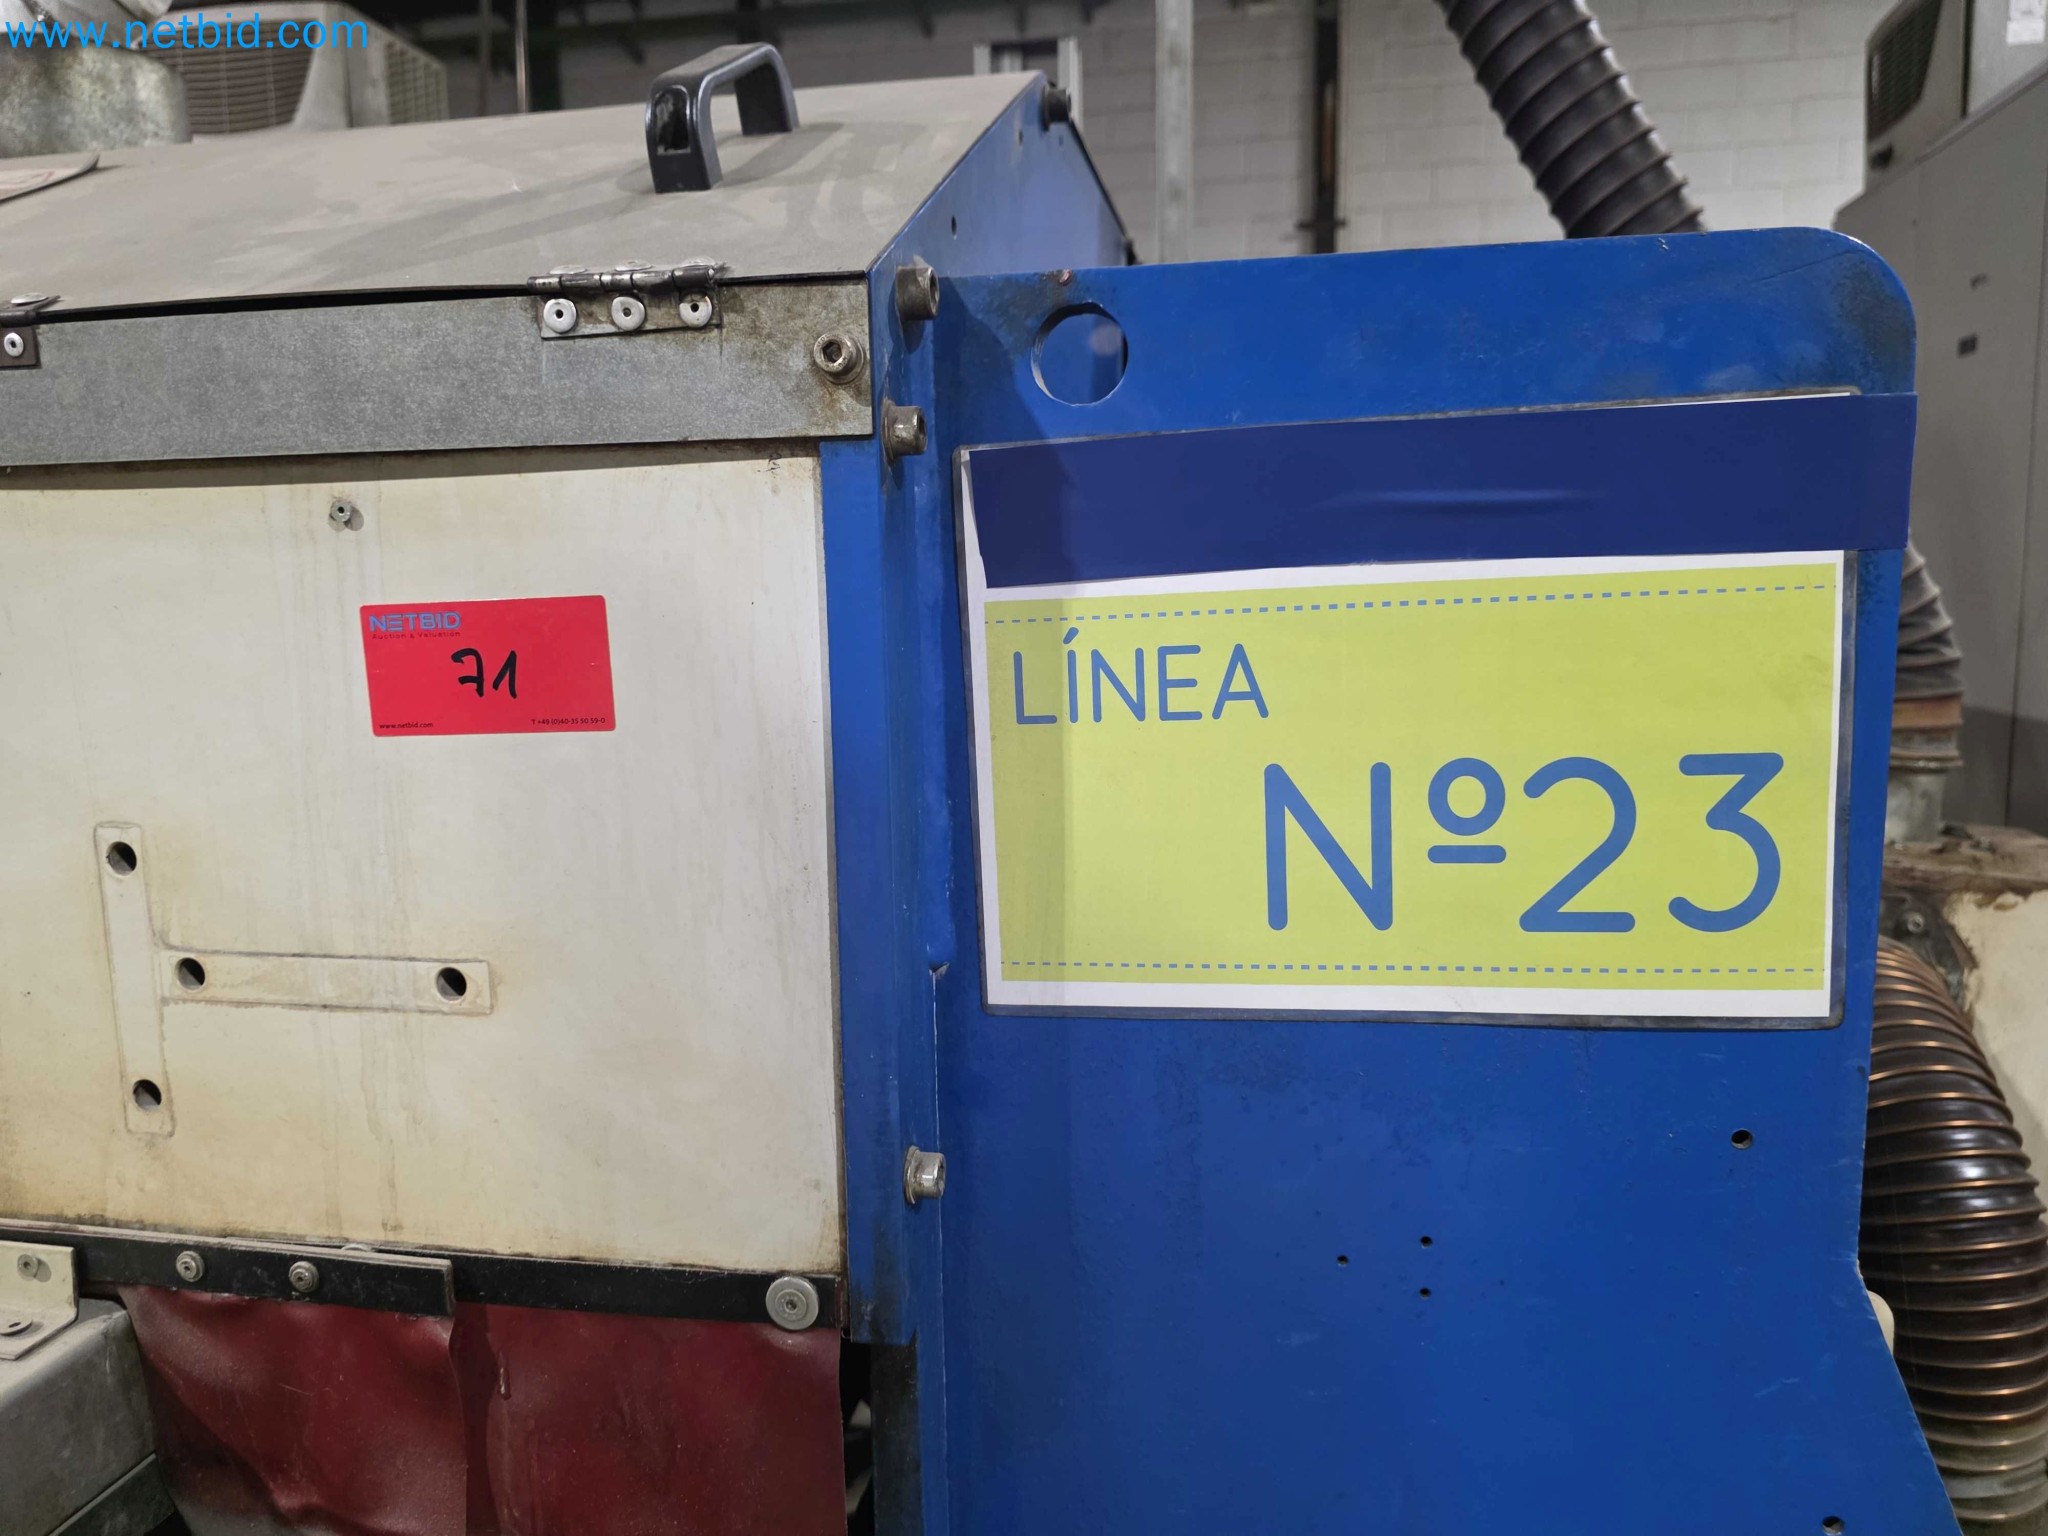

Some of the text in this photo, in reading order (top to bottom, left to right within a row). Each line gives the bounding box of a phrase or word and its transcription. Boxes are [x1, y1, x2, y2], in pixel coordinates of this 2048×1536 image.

[369, 611, 461, 632] NETBID
[372, 632, 407, 640] Auction
[451, 647, 517, 699] 71
[1012, 626, 1270, 726] LÍNEA
[379, 721, 434, 729] www.netbid.com
